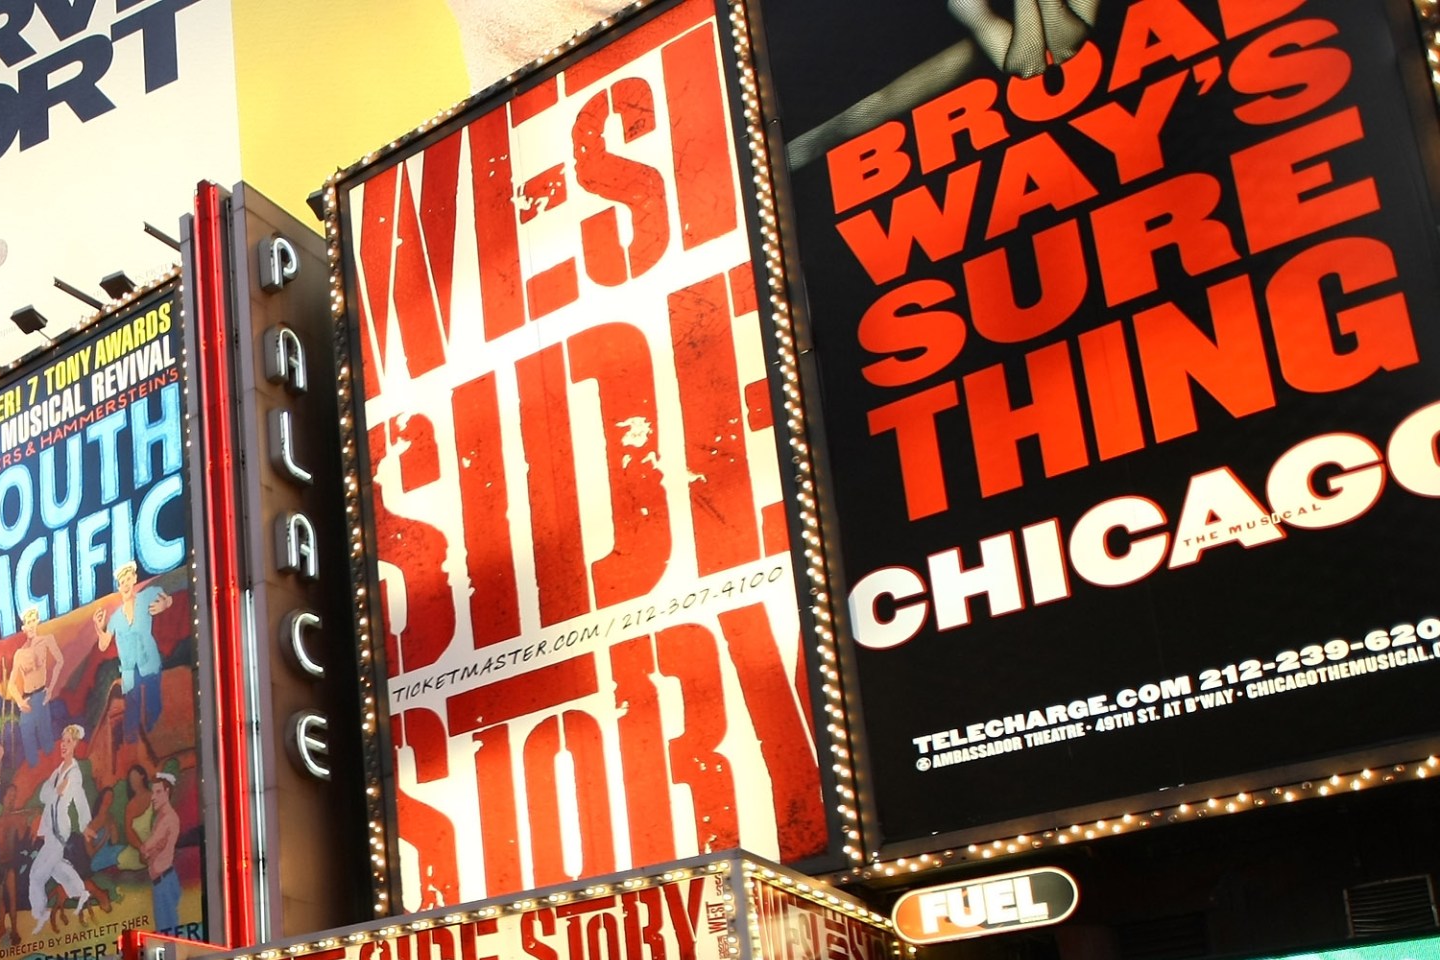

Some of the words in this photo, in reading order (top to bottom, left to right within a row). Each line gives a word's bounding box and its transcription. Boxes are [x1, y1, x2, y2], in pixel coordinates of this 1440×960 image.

[835, 18, 1353, 286] WAY'S
[857, 105, 1381, 388] SURE
[1, 385, 86, 454] MUSICAL
[91, 334, 176, 406] REVIVAL
[25, 441, 36, 457] &
[40, 368, 180, 449] HAMMERSTEIN'S
[27, 375, 39, 406] 7
[43, 345, 92, 396] TONY
[866, 236, 1420, 522] THING
[262, 231, 331, 782] PALACE
[1183, 530, 1220, 548] THE
[1229, 502, 1322, 536] MUSICAL
[392, 622, 603, 704] TICKETMASTER.COM
[621, 564, 784, 632] 212-307-4100
[912, 673, 1193, 755] TELECHARGE.COM
[932, 735, 1023, 769] AMBASSADOR
[1024, 724, 1086, 750] THEATRE
[1094, 711, 1136, 733] 49TH
[1136, 705, 1161, 726] ST.
[1163, 701, 1183, 720] AT
[1184, 688, 1234, 714] B'WAY
[0, 936, 45, 960] DIRECTED
[48, 934, 63, 948] BY
[64, 923, 120, 944] BARTLETT
[122, 914, 150, 931] SHER
[918, 876, 1050, 936] FUEL
